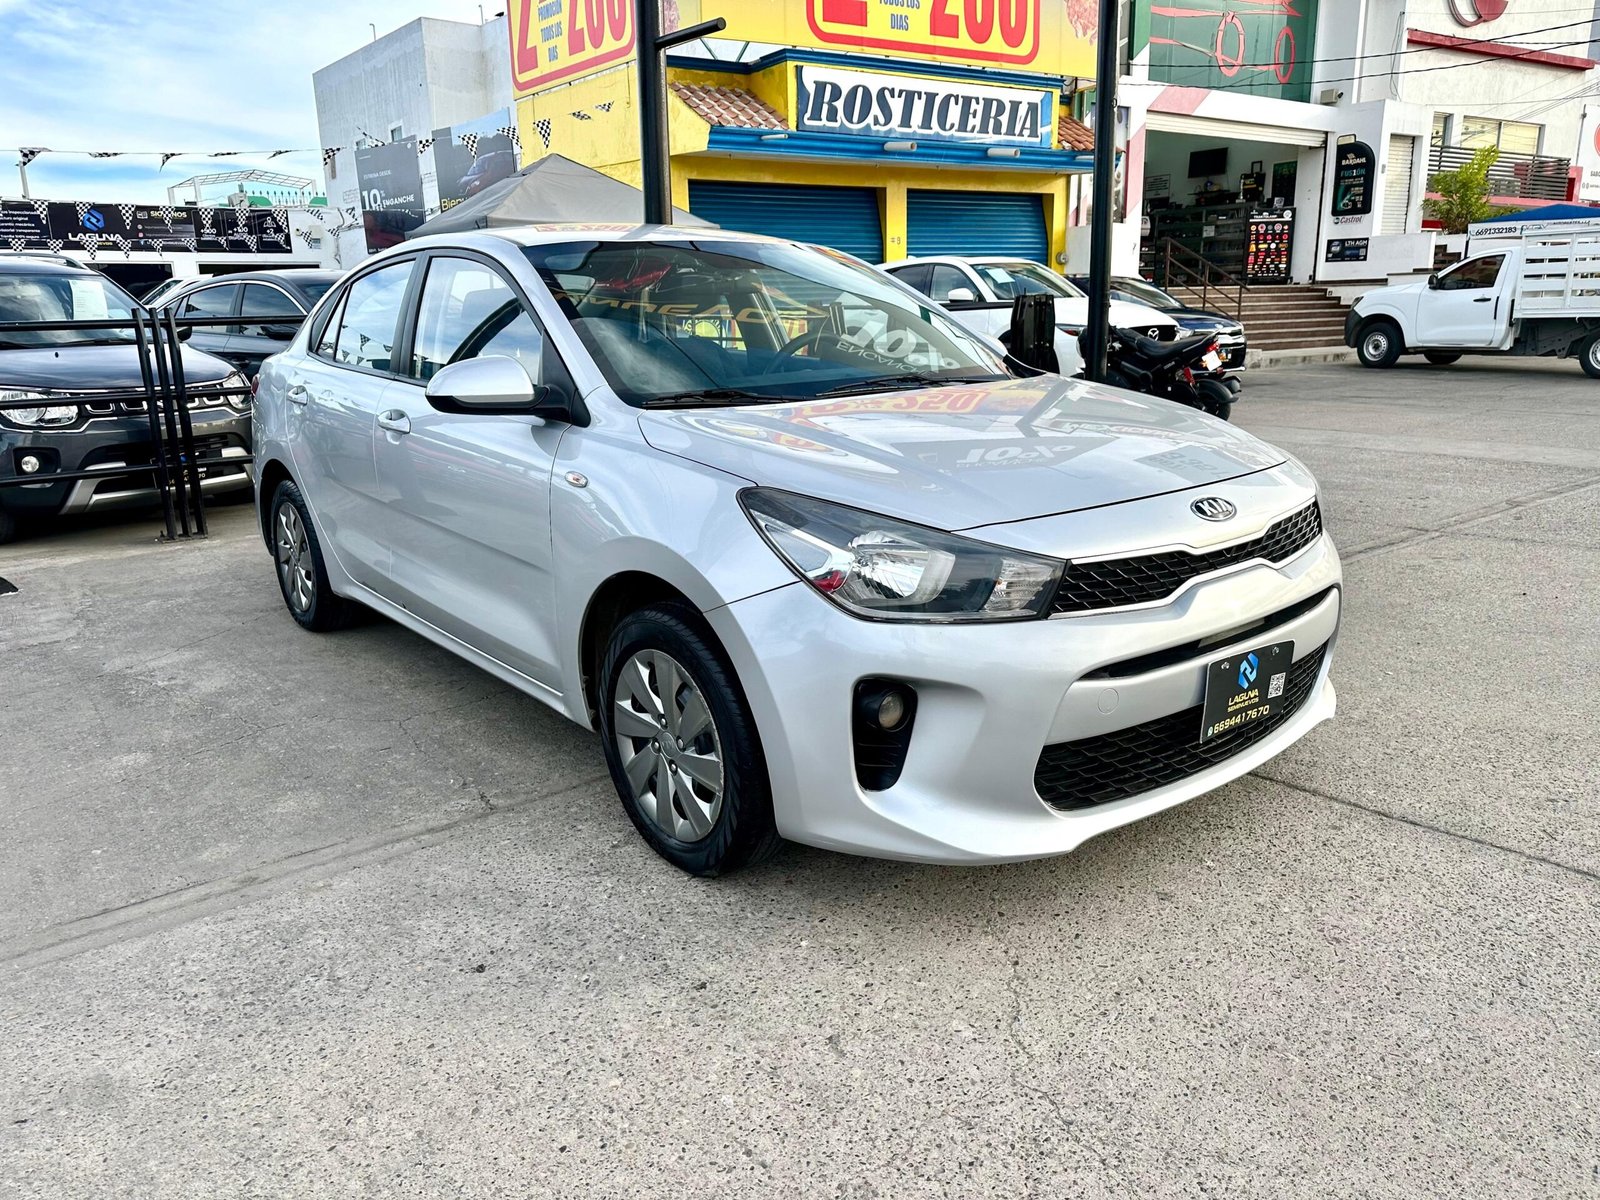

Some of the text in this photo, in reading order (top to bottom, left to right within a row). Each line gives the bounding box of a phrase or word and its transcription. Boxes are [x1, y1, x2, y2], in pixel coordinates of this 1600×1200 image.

[891, 13, 909, 31] DIAS
[541, 24, 555, 43] TODOS
[548, 45, 559, 62] DIAS
[807, 80, 1040, 138] ROSTICERIA
[1340, 216, 1362, 225] Castrol
[68, 233, 123, 241] LAGUNA
[1475, 226, 1517, 236] 6691332183
[1195, 498, 1234, 516] KIA
[1227, 697, 1260, 712] SEMINUEVOS
[1228, 689, 1259, 705] LAGUNA
[1213, 705, 1270, 734] 6694417670
